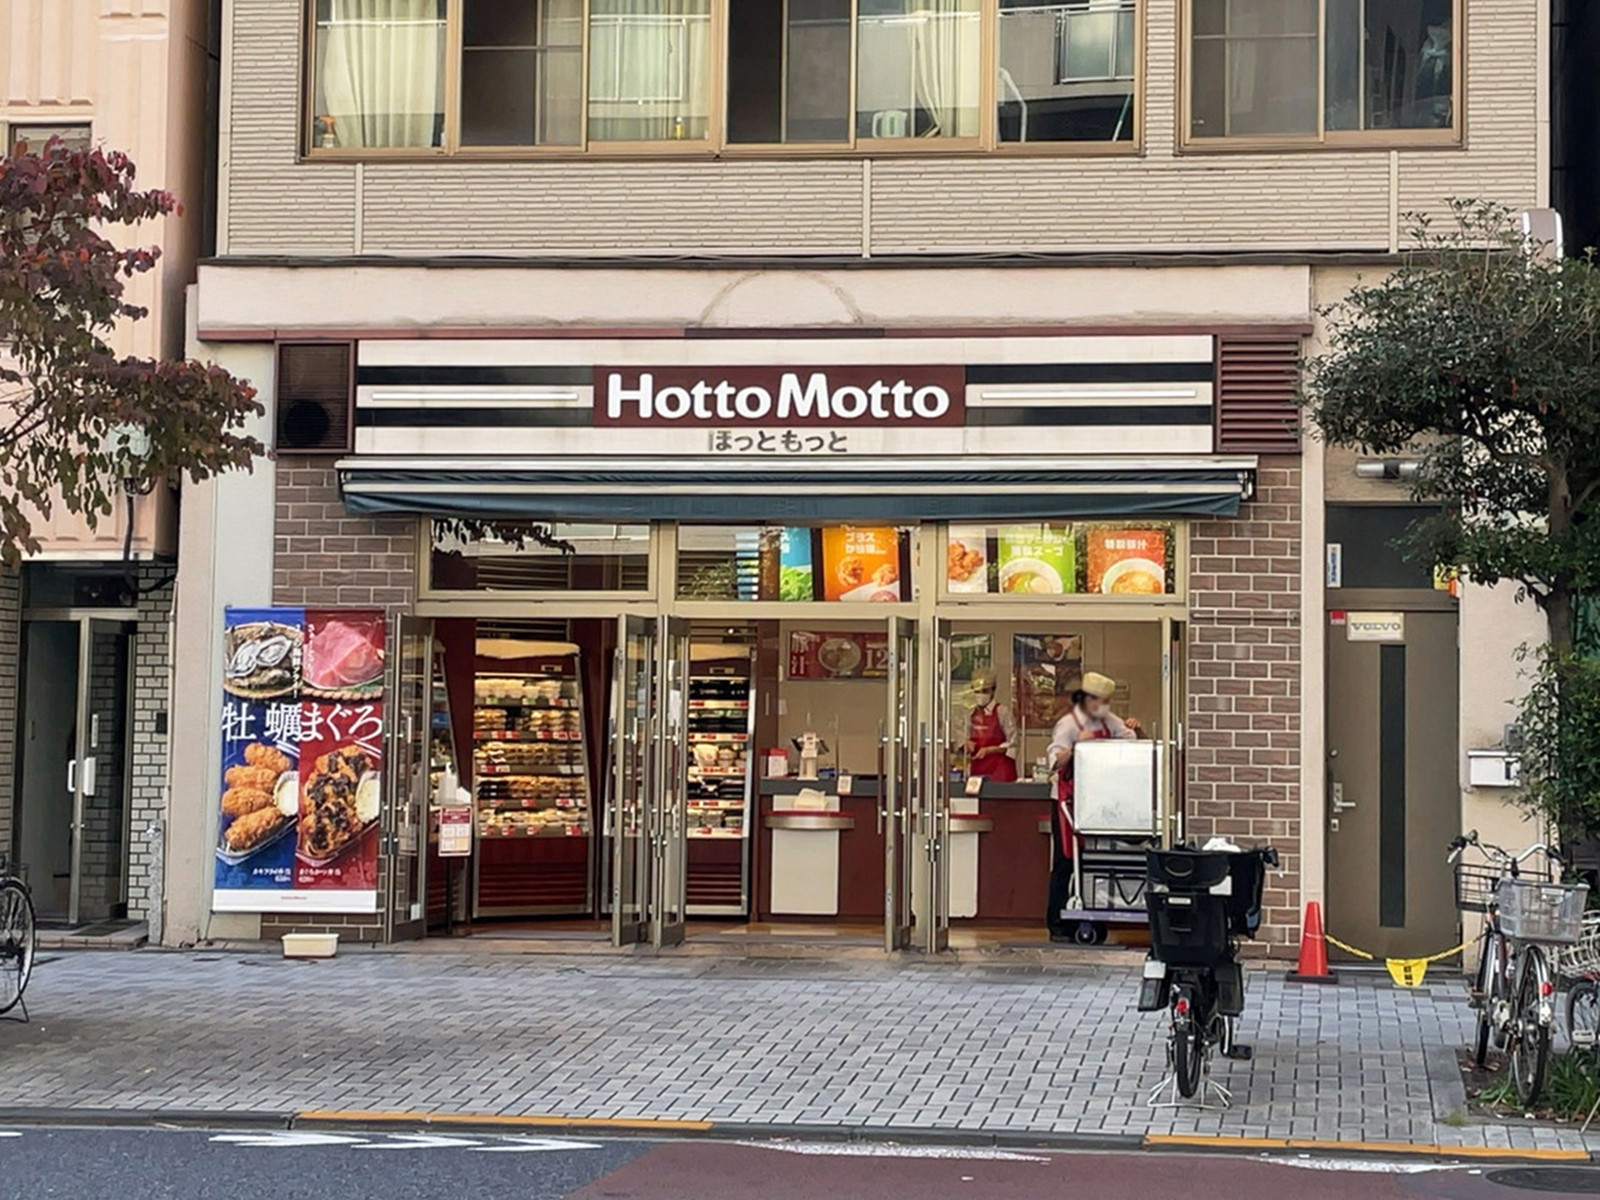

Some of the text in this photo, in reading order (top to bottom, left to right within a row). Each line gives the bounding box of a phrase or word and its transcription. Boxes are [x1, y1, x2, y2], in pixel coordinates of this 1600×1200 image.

[607, 373, 950, 419] Hotto Motto
[708, 430, 848, 452] ほっともっと
[1351, 622, 1402, 631] VOLVO
[300, 702, 383, 742] まぐろ
